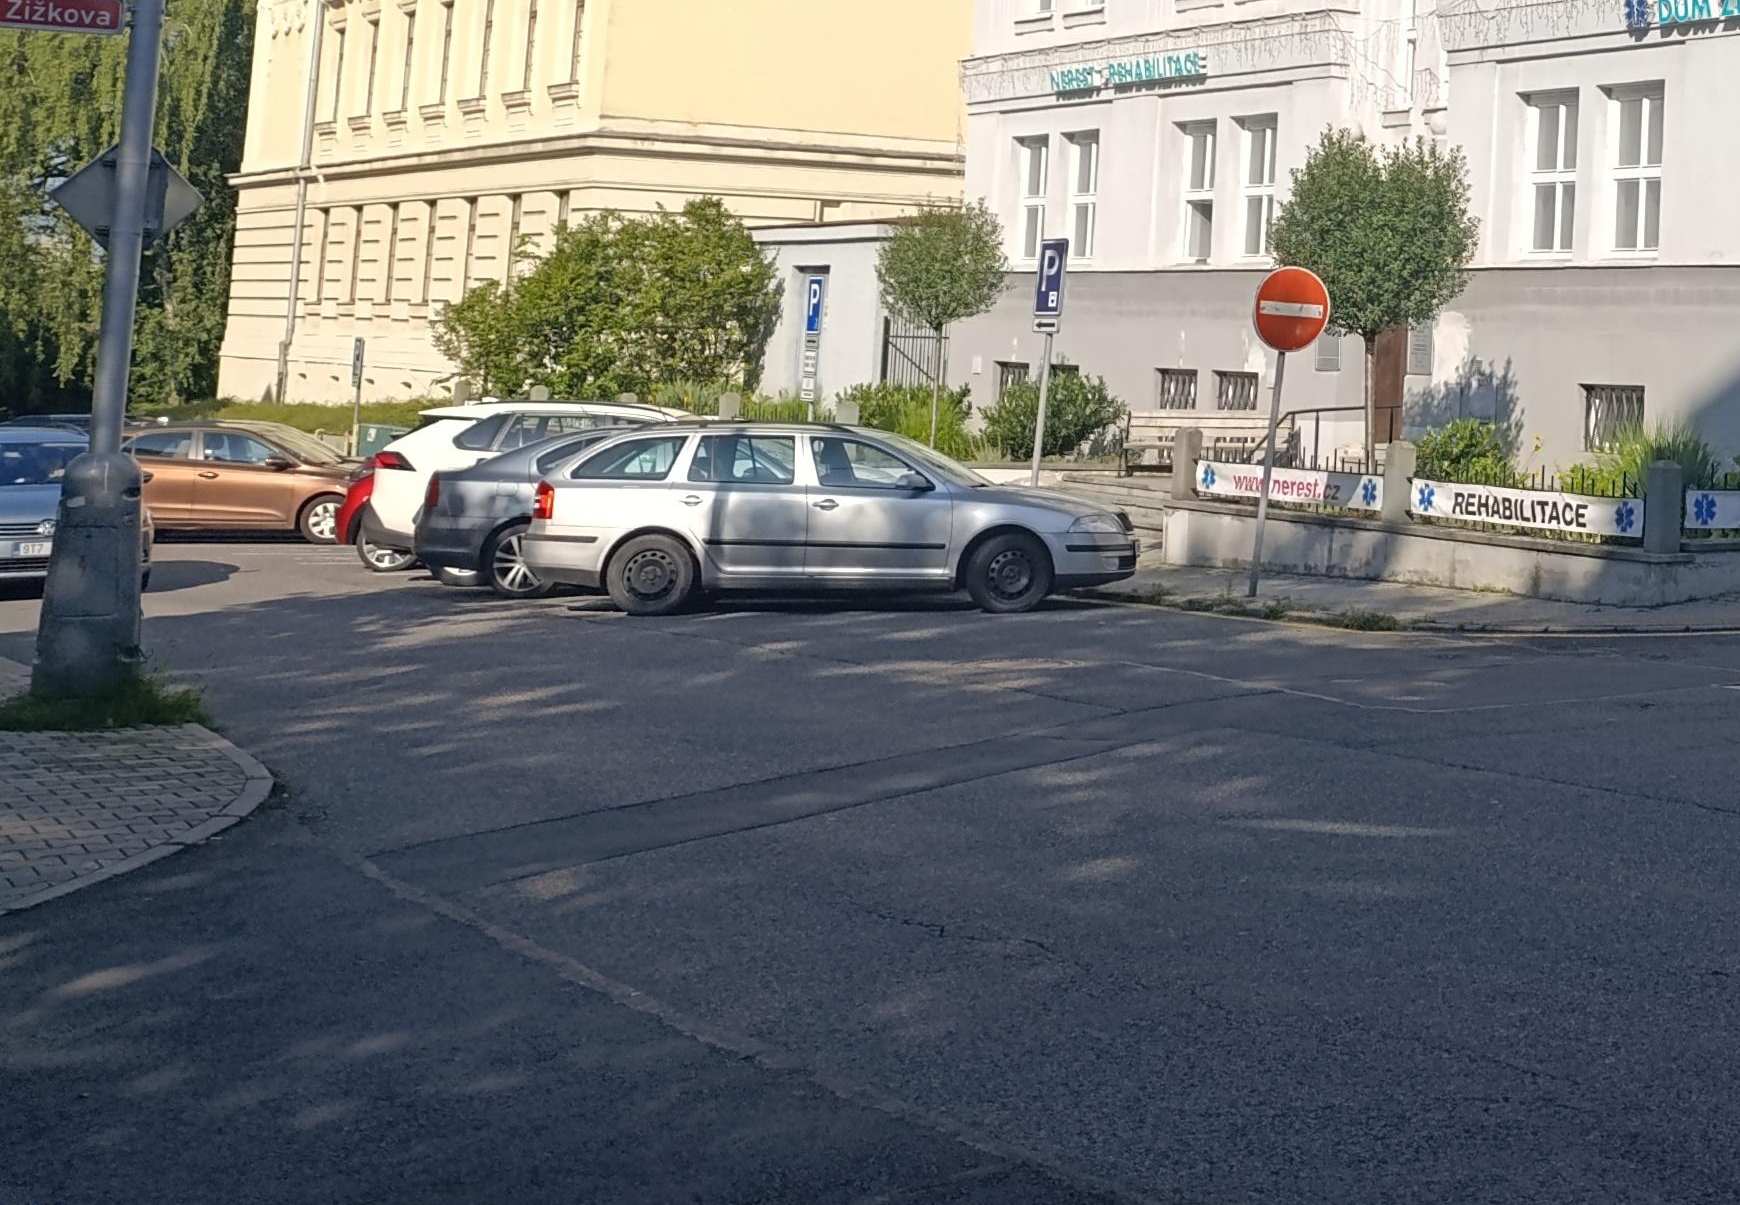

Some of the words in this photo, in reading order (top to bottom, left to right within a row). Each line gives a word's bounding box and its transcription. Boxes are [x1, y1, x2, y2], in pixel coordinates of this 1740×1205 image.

[1107, 52, 1202, 85] REHABILITACE
[1040, 249, 1060, 292] P
[809, 283, 820, 316] P
[1451, 491, 1588, 528] REHABILITACE
